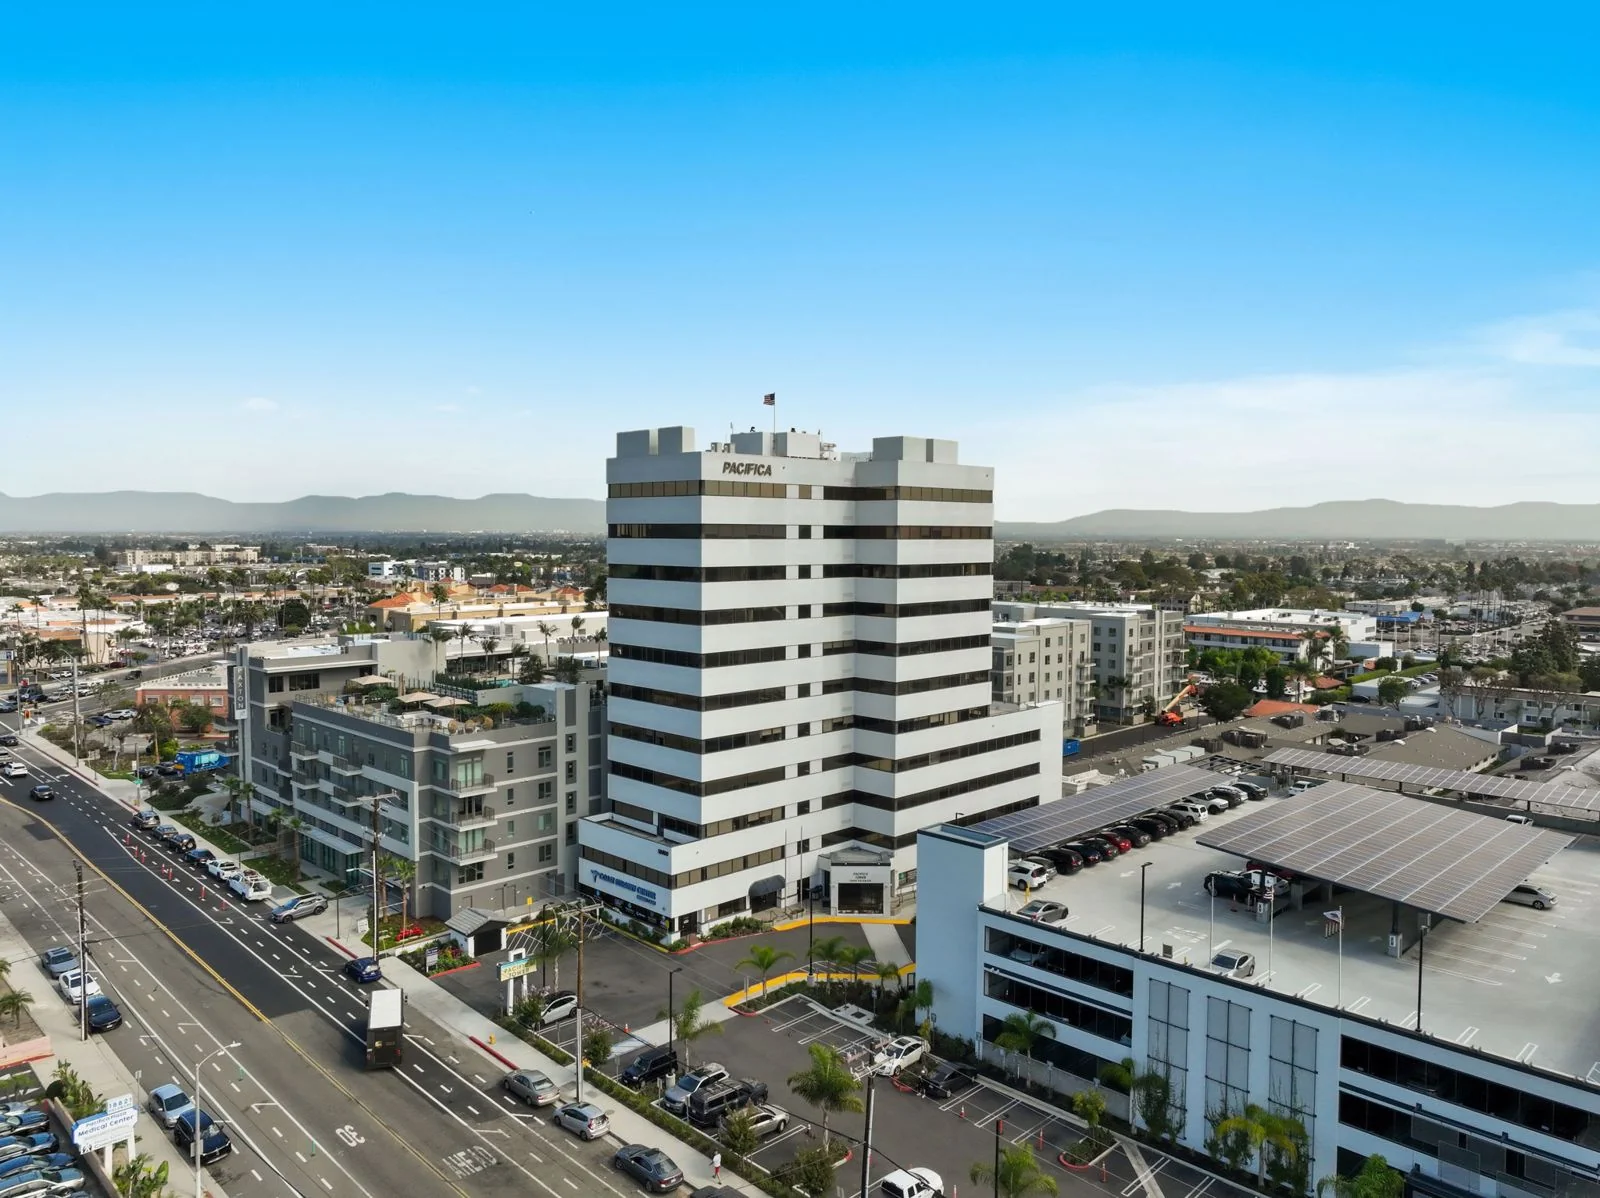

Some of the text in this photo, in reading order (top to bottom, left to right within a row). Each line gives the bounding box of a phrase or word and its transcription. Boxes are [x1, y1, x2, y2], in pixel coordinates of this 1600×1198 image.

[722, 461, 772, 476] PACIFICA
[78, 1123, 108, 1136] Medical
[109, 1115, 134, 1127] Center
[441, 1145, 497, 1179] AHEAD
